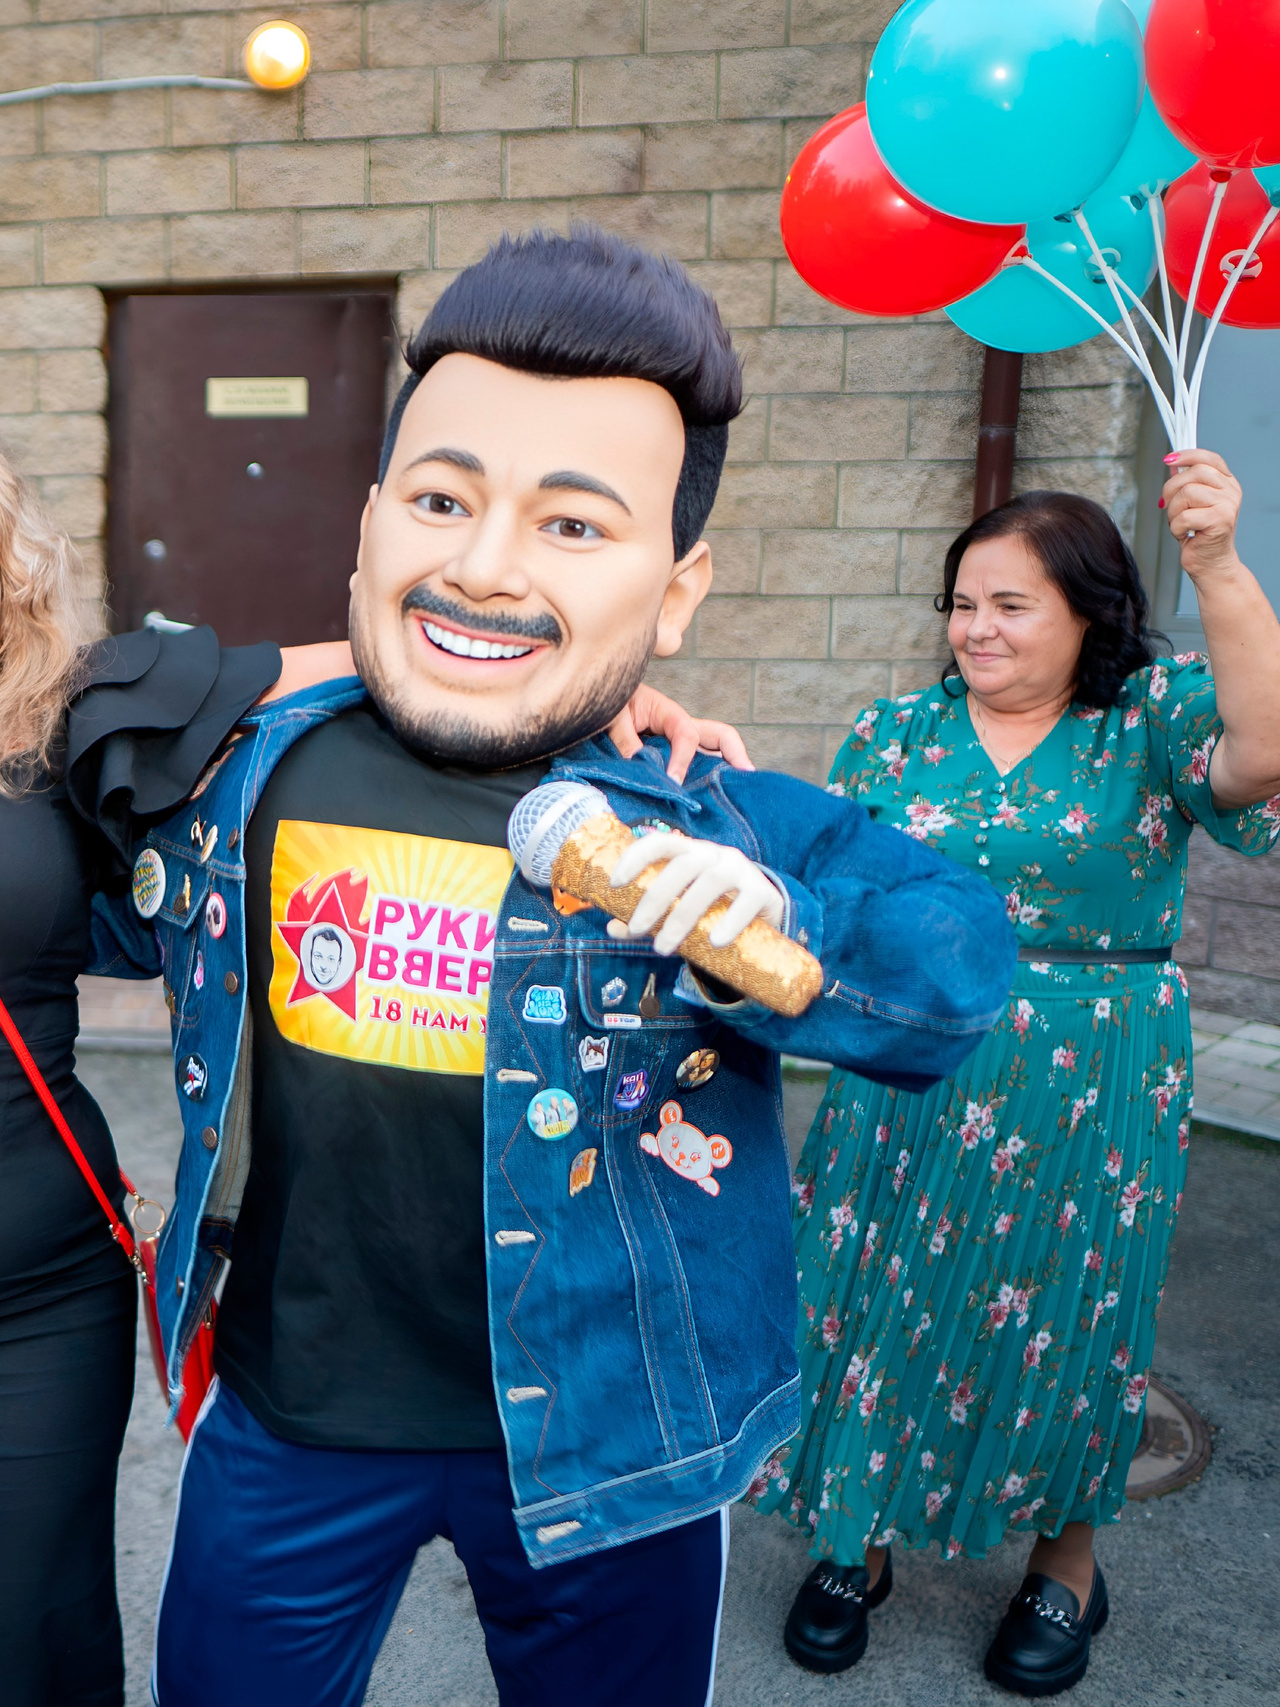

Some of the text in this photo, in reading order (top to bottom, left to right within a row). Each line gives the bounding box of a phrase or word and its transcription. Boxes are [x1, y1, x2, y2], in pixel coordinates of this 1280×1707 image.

[373, 895, 496, 952] РУКИ
[367, 943, 493, 996] ВВЕР
[369, 995, 404, 1022] 18
[411, 1005, 470, 1034] НАМ
